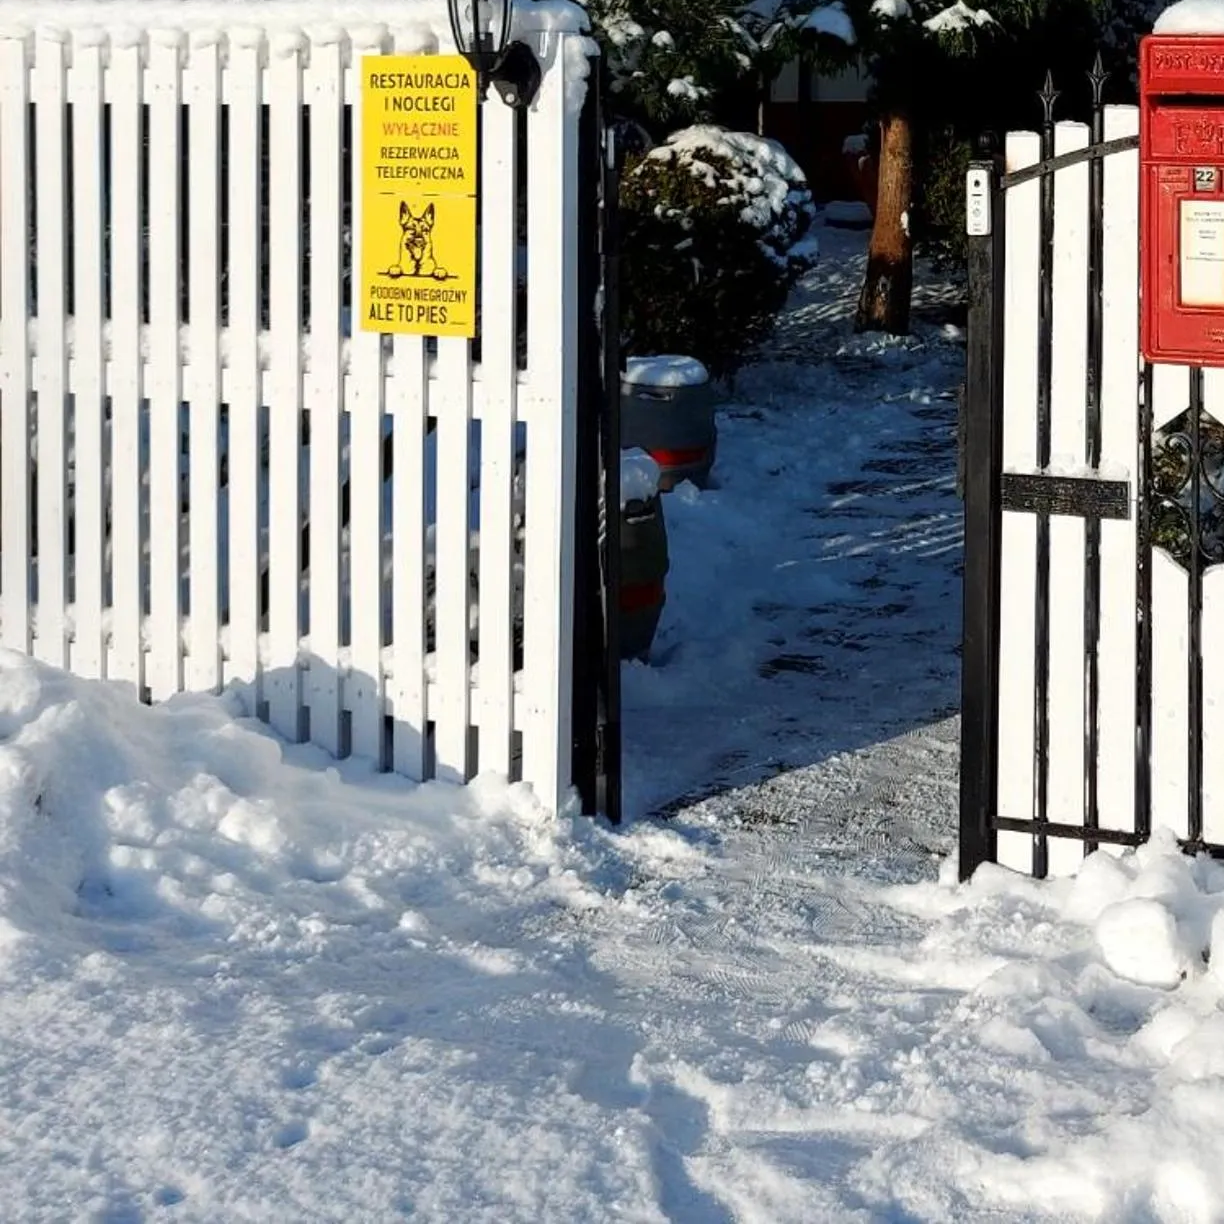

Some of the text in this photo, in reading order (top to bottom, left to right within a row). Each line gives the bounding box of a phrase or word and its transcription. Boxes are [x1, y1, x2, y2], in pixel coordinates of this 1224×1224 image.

[370, 73, 471, 89] RESTAURACJA
[384, 96, 455, 112] I NOCLEGI
[382, 122, 460, 140] WYŁĄCZNIE
[380, 146, 460, 160] REZERWACJA
[375, 165, 465, 180] TELEFONICZNA
[1196, 170, 1215, 182] 22
[370, 285, 412, 301] PODOBNO
[369, 303, 448, 324] ALE TO PIES
